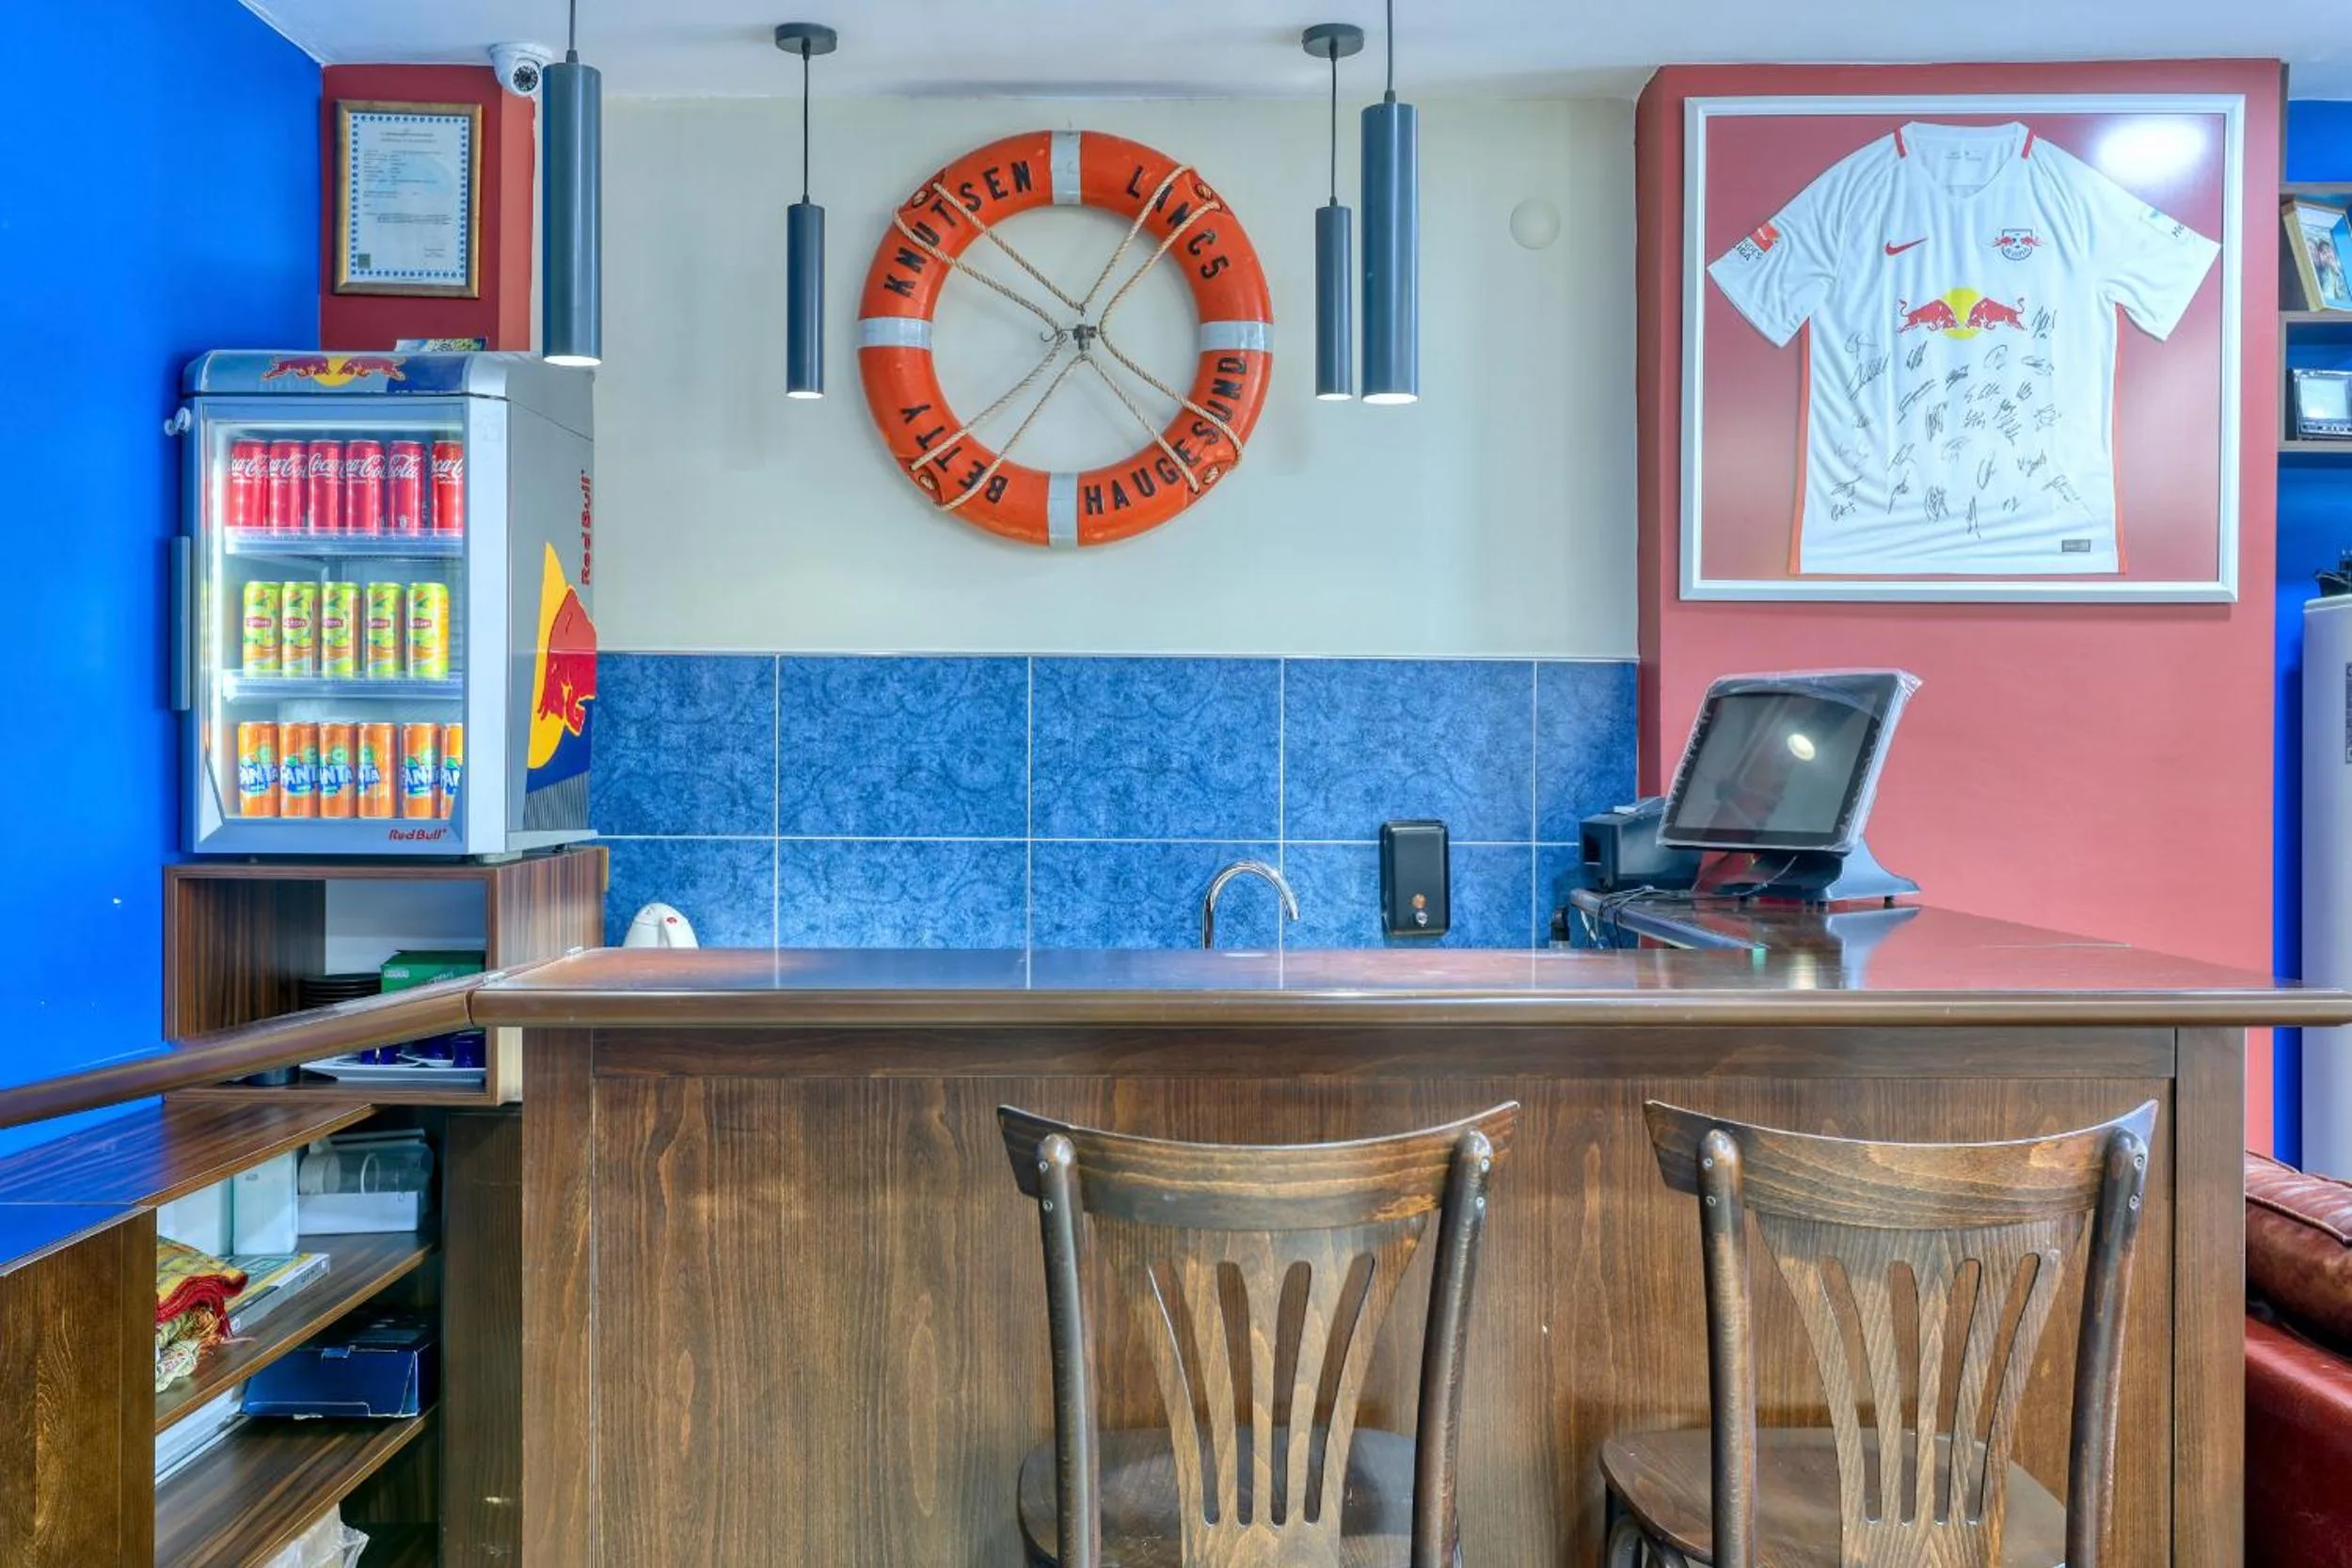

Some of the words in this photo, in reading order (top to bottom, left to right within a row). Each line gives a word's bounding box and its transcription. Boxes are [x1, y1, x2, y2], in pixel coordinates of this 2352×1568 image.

[883, 161, 1032, 297] KNUTSEN
[900, 404, 1009, 504] BETTY
[1084, 356, 1248, 515] HAUGESUND
[581, 476, 591, 528] Bull
[581, 531, 591, 585] Red
[389, 829, 415, 840] Red
[416, 829, 442, 840] Bull
